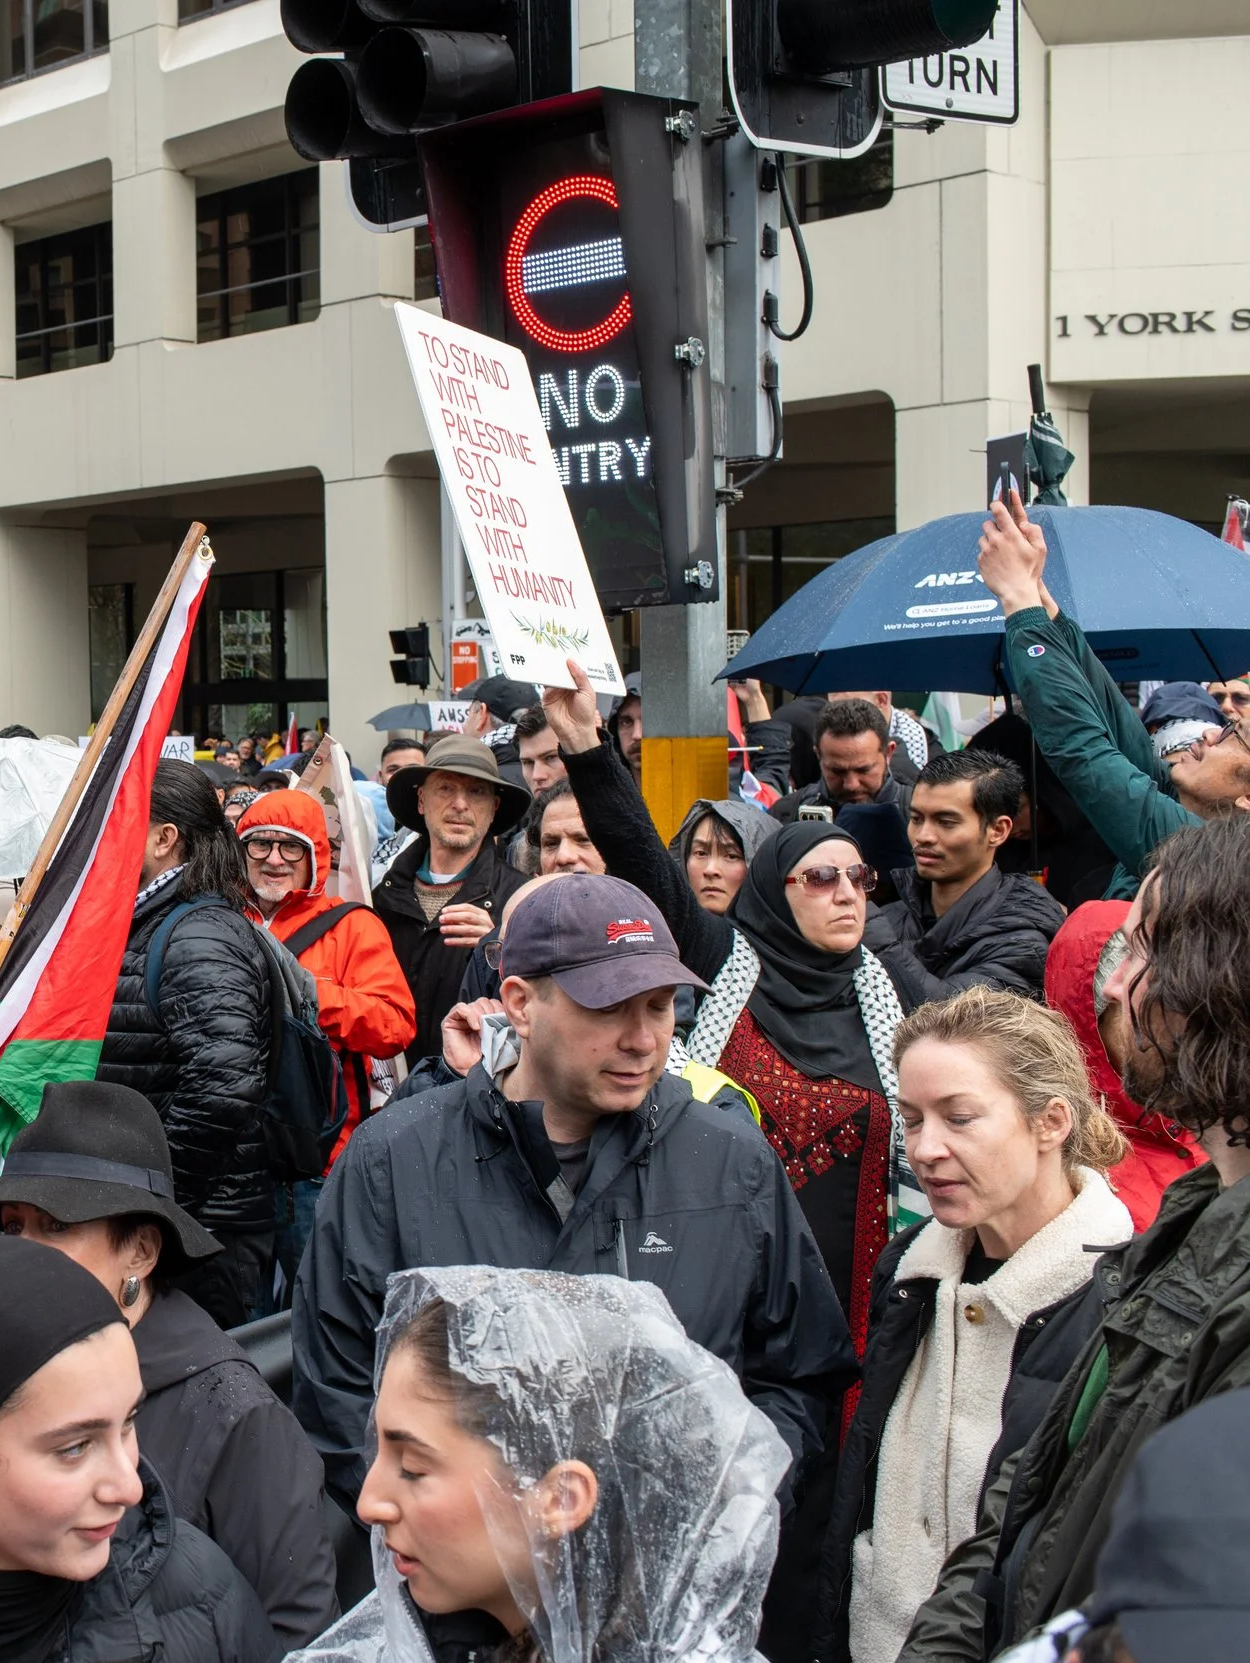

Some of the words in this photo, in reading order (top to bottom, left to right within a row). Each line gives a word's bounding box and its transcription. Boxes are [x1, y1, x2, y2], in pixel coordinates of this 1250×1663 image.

[1055, 315, 1071, 338] 1
[1084, 311, 1216, 337] YORK
[1230, 308, 1250, 331] S
[418, 331, 449, 370] TO
[449, 343, 510, 391] STAND
[429, 368, 482, 415] WITH
[539, 364, 625, 431] NO
[441, 408, 537, 466] PALESTINE
[452, 446, 474, 480] IS
[474, 452, 501, 488] TO
[551, 436, 651, 486] NTRY
[465, 485, 528, 529] STAND
[475, 523, 529, 564] WITH
[488, 562, 577, 610] HUMANITY
[914, 571, 976, 588] ANZ
[458, 646, 470, 656] NO
[510, 653, 526, 666] FPP
